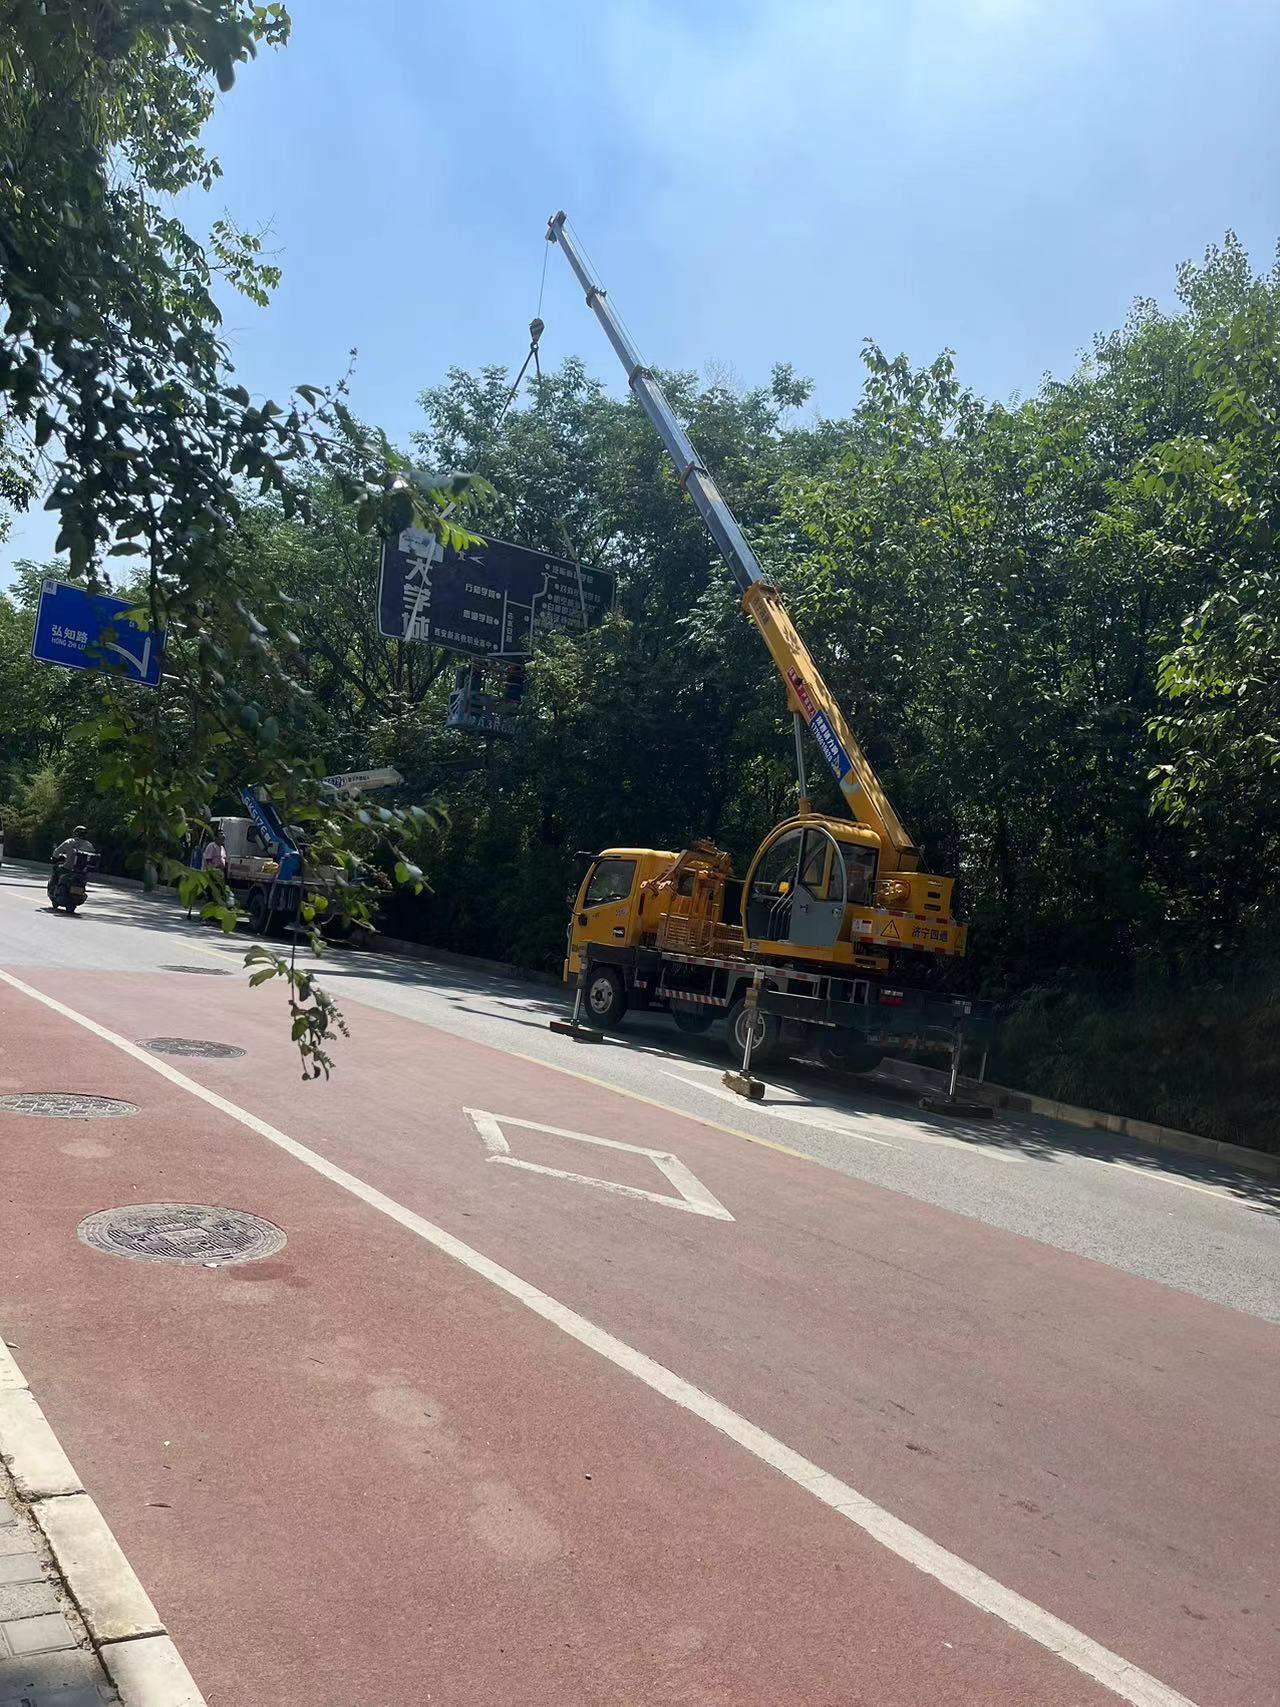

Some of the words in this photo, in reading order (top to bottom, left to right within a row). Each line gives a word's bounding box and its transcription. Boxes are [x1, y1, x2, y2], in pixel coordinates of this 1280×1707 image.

[402, 558, 433, 641] 大学城
[51, 624, 88, 643] 弘知路
[51, 637, 67, 646] HONG
[67, 641, 77, 649] ZHI
[77, 643, 87, 651] LU
